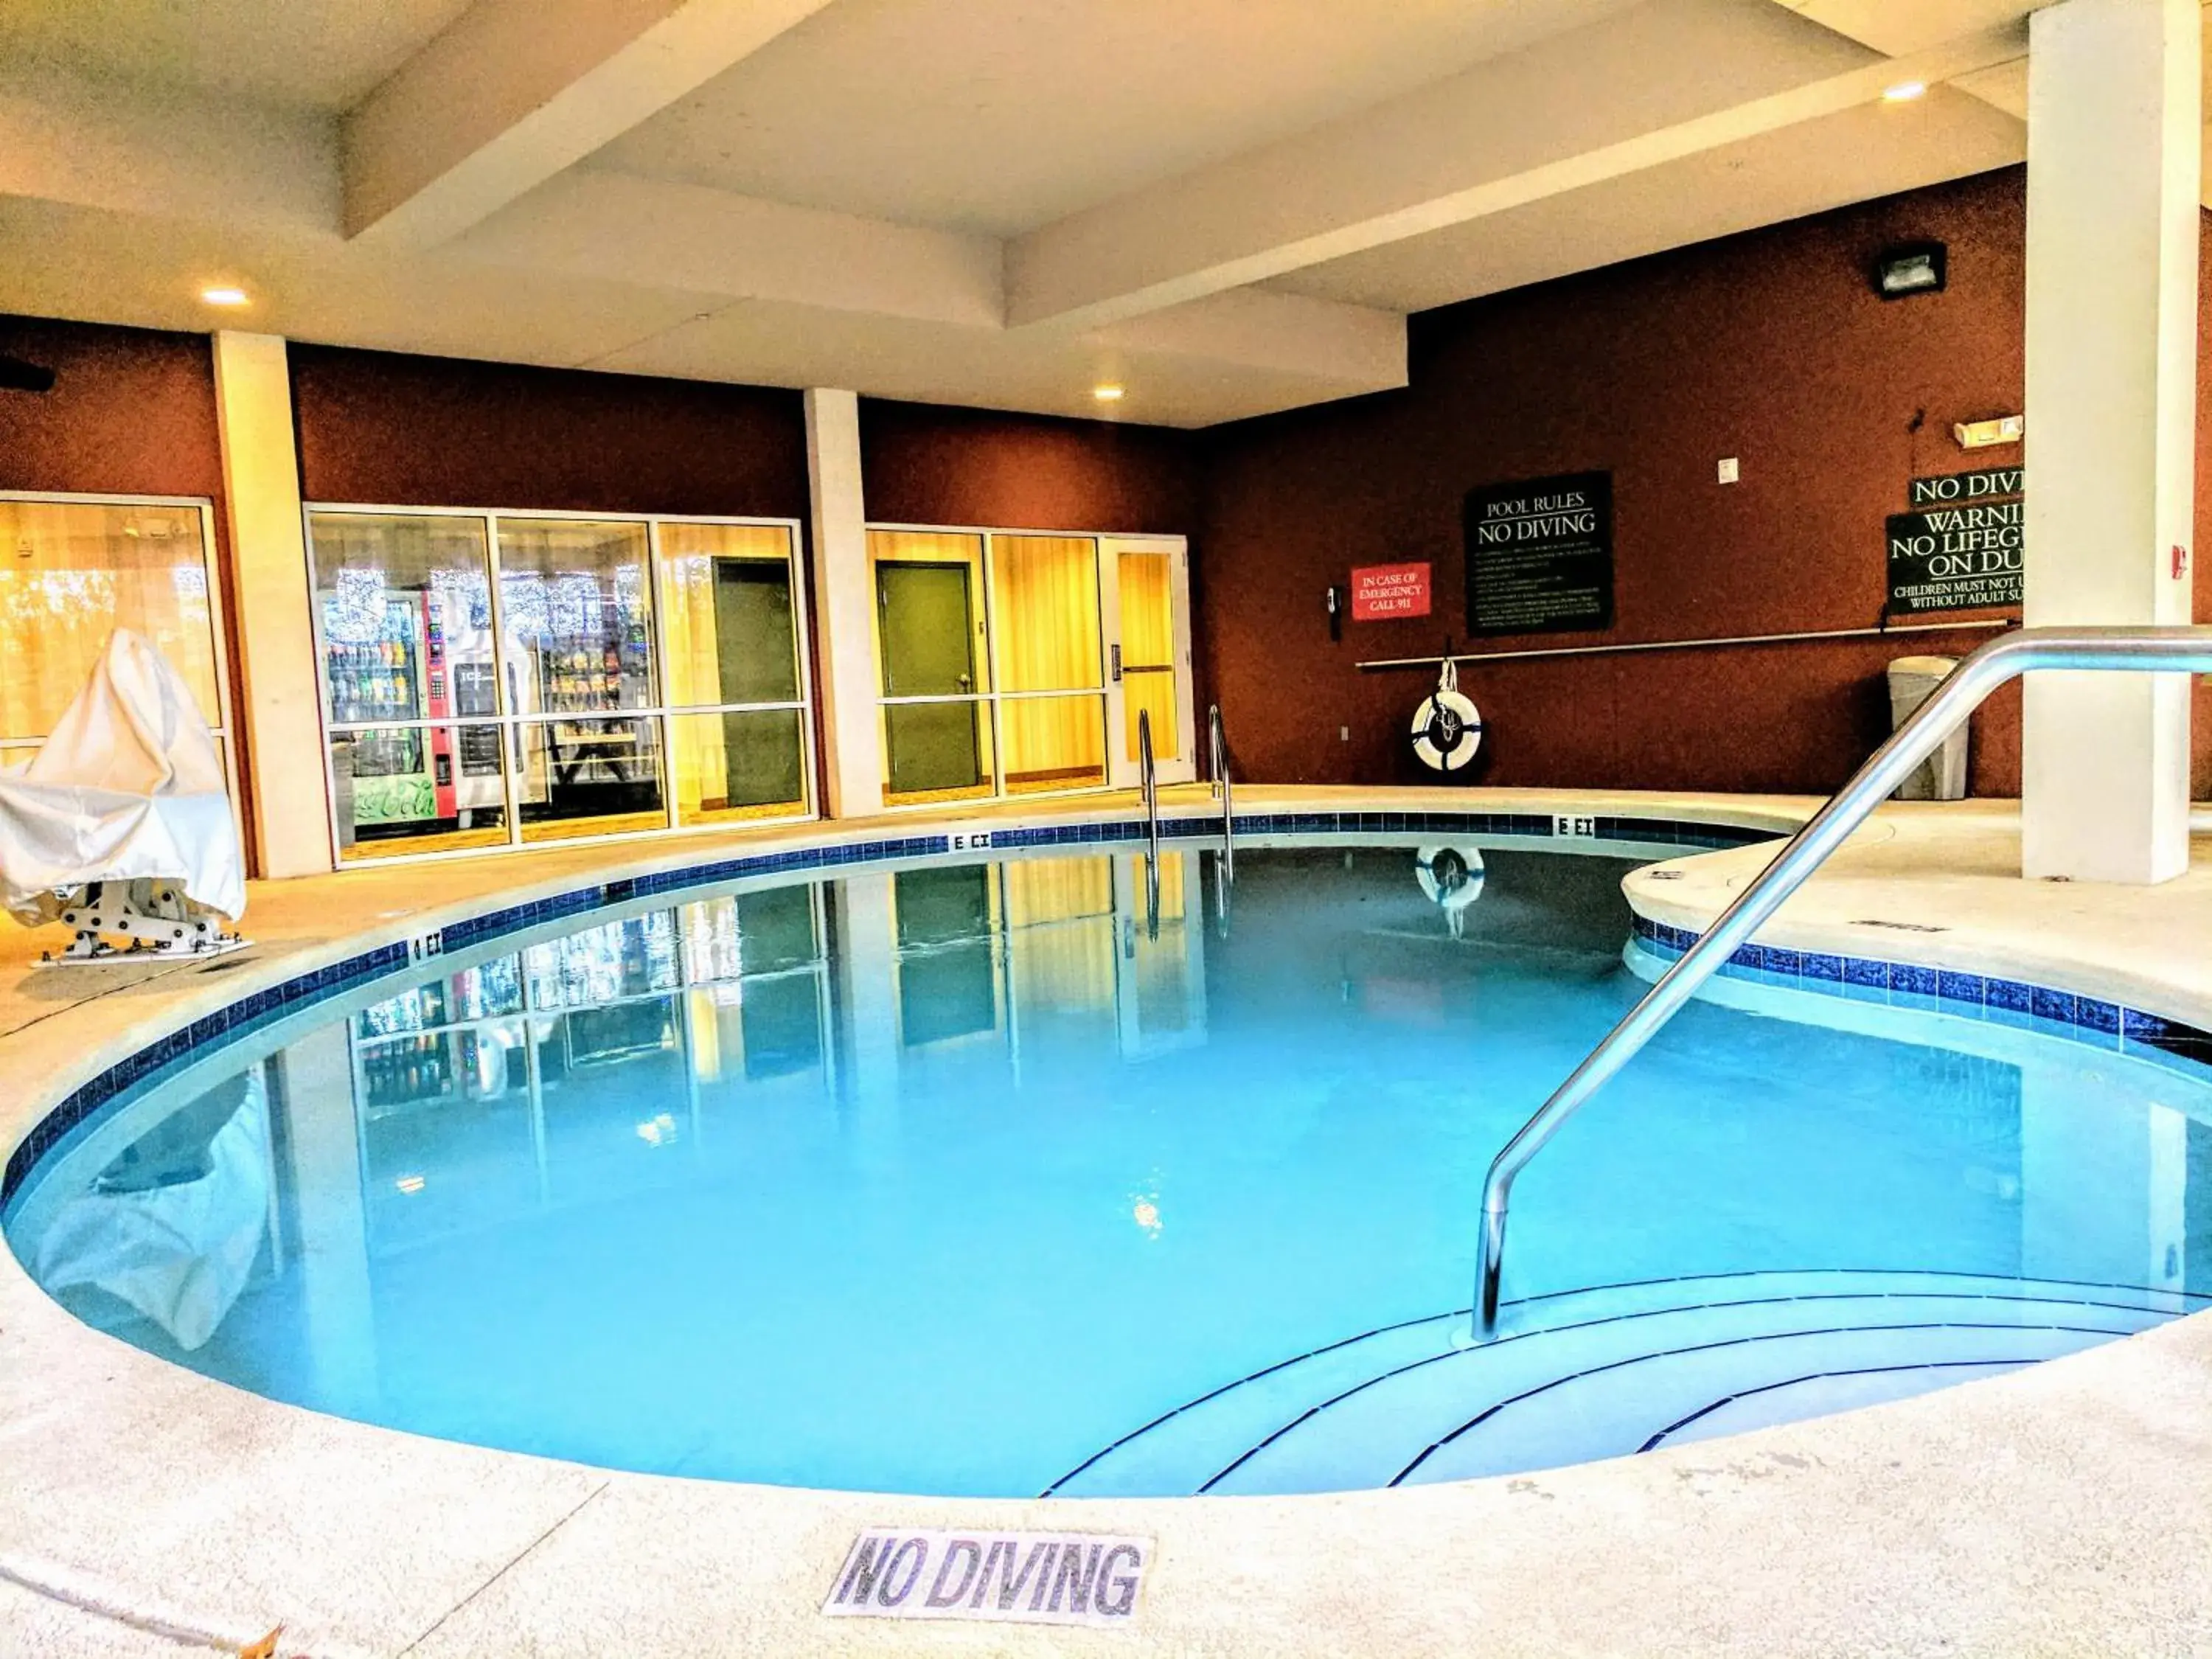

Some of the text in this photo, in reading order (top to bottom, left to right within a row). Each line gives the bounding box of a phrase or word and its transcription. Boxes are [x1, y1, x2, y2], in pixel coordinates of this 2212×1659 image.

[1915, 479, 1960, 502] NO
[1487, 492, 1585, 518] POOL RULES
[1478, 513, 1596, 545] NO DIVING
[1923, 504, 2024, 533] WARNI
[1892, 526, 2024, 559] NO LIFEG
[1928, 554, 1972, 577] ON
[1363, 572, 1417, 588] IN CASE OF
[1894, 582, 1952, 599] CHILDREN
[1954, 579, 1986, 594] MUST
[1989, 577, 2015, 590] NOT
[1360, 585, 1422, 599] EMERGENCY
[1910, 594, 1966, 608] WITHOUT
[1967, 591, 2006, 604] ADULT
[1369, 598, 1411, 611] CALL 911
[834, 1537, 1142, 1616] NO DIVING
